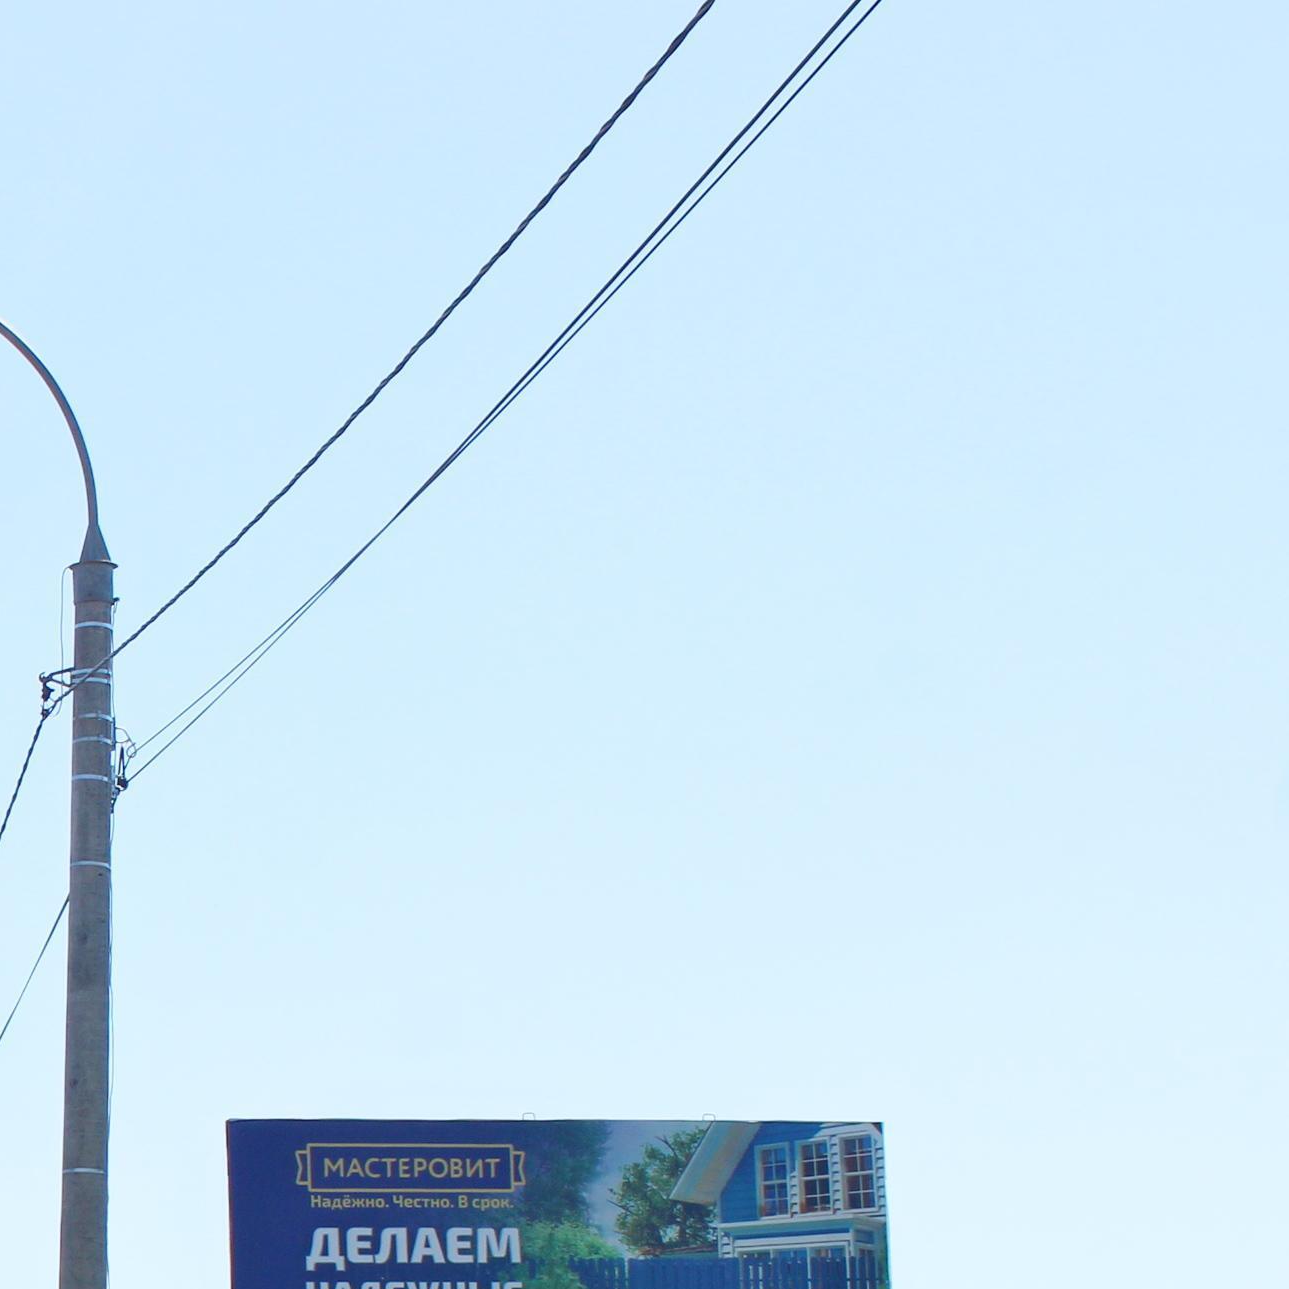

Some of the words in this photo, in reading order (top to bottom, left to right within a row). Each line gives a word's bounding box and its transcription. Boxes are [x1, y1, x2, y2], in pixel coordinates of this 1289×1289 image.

[323, 1157, 501, 1179] МАСТЕРОВИТ
[310, 1194, 390, 1210] Надёжно.
[392, 1195, 454, 1209] Честно.
[457, 1195, 469, 1209] В
[472, 1197, 514, 1211] срок.
[305, 1226, 522, 1271] ДЕЛАЕМ
